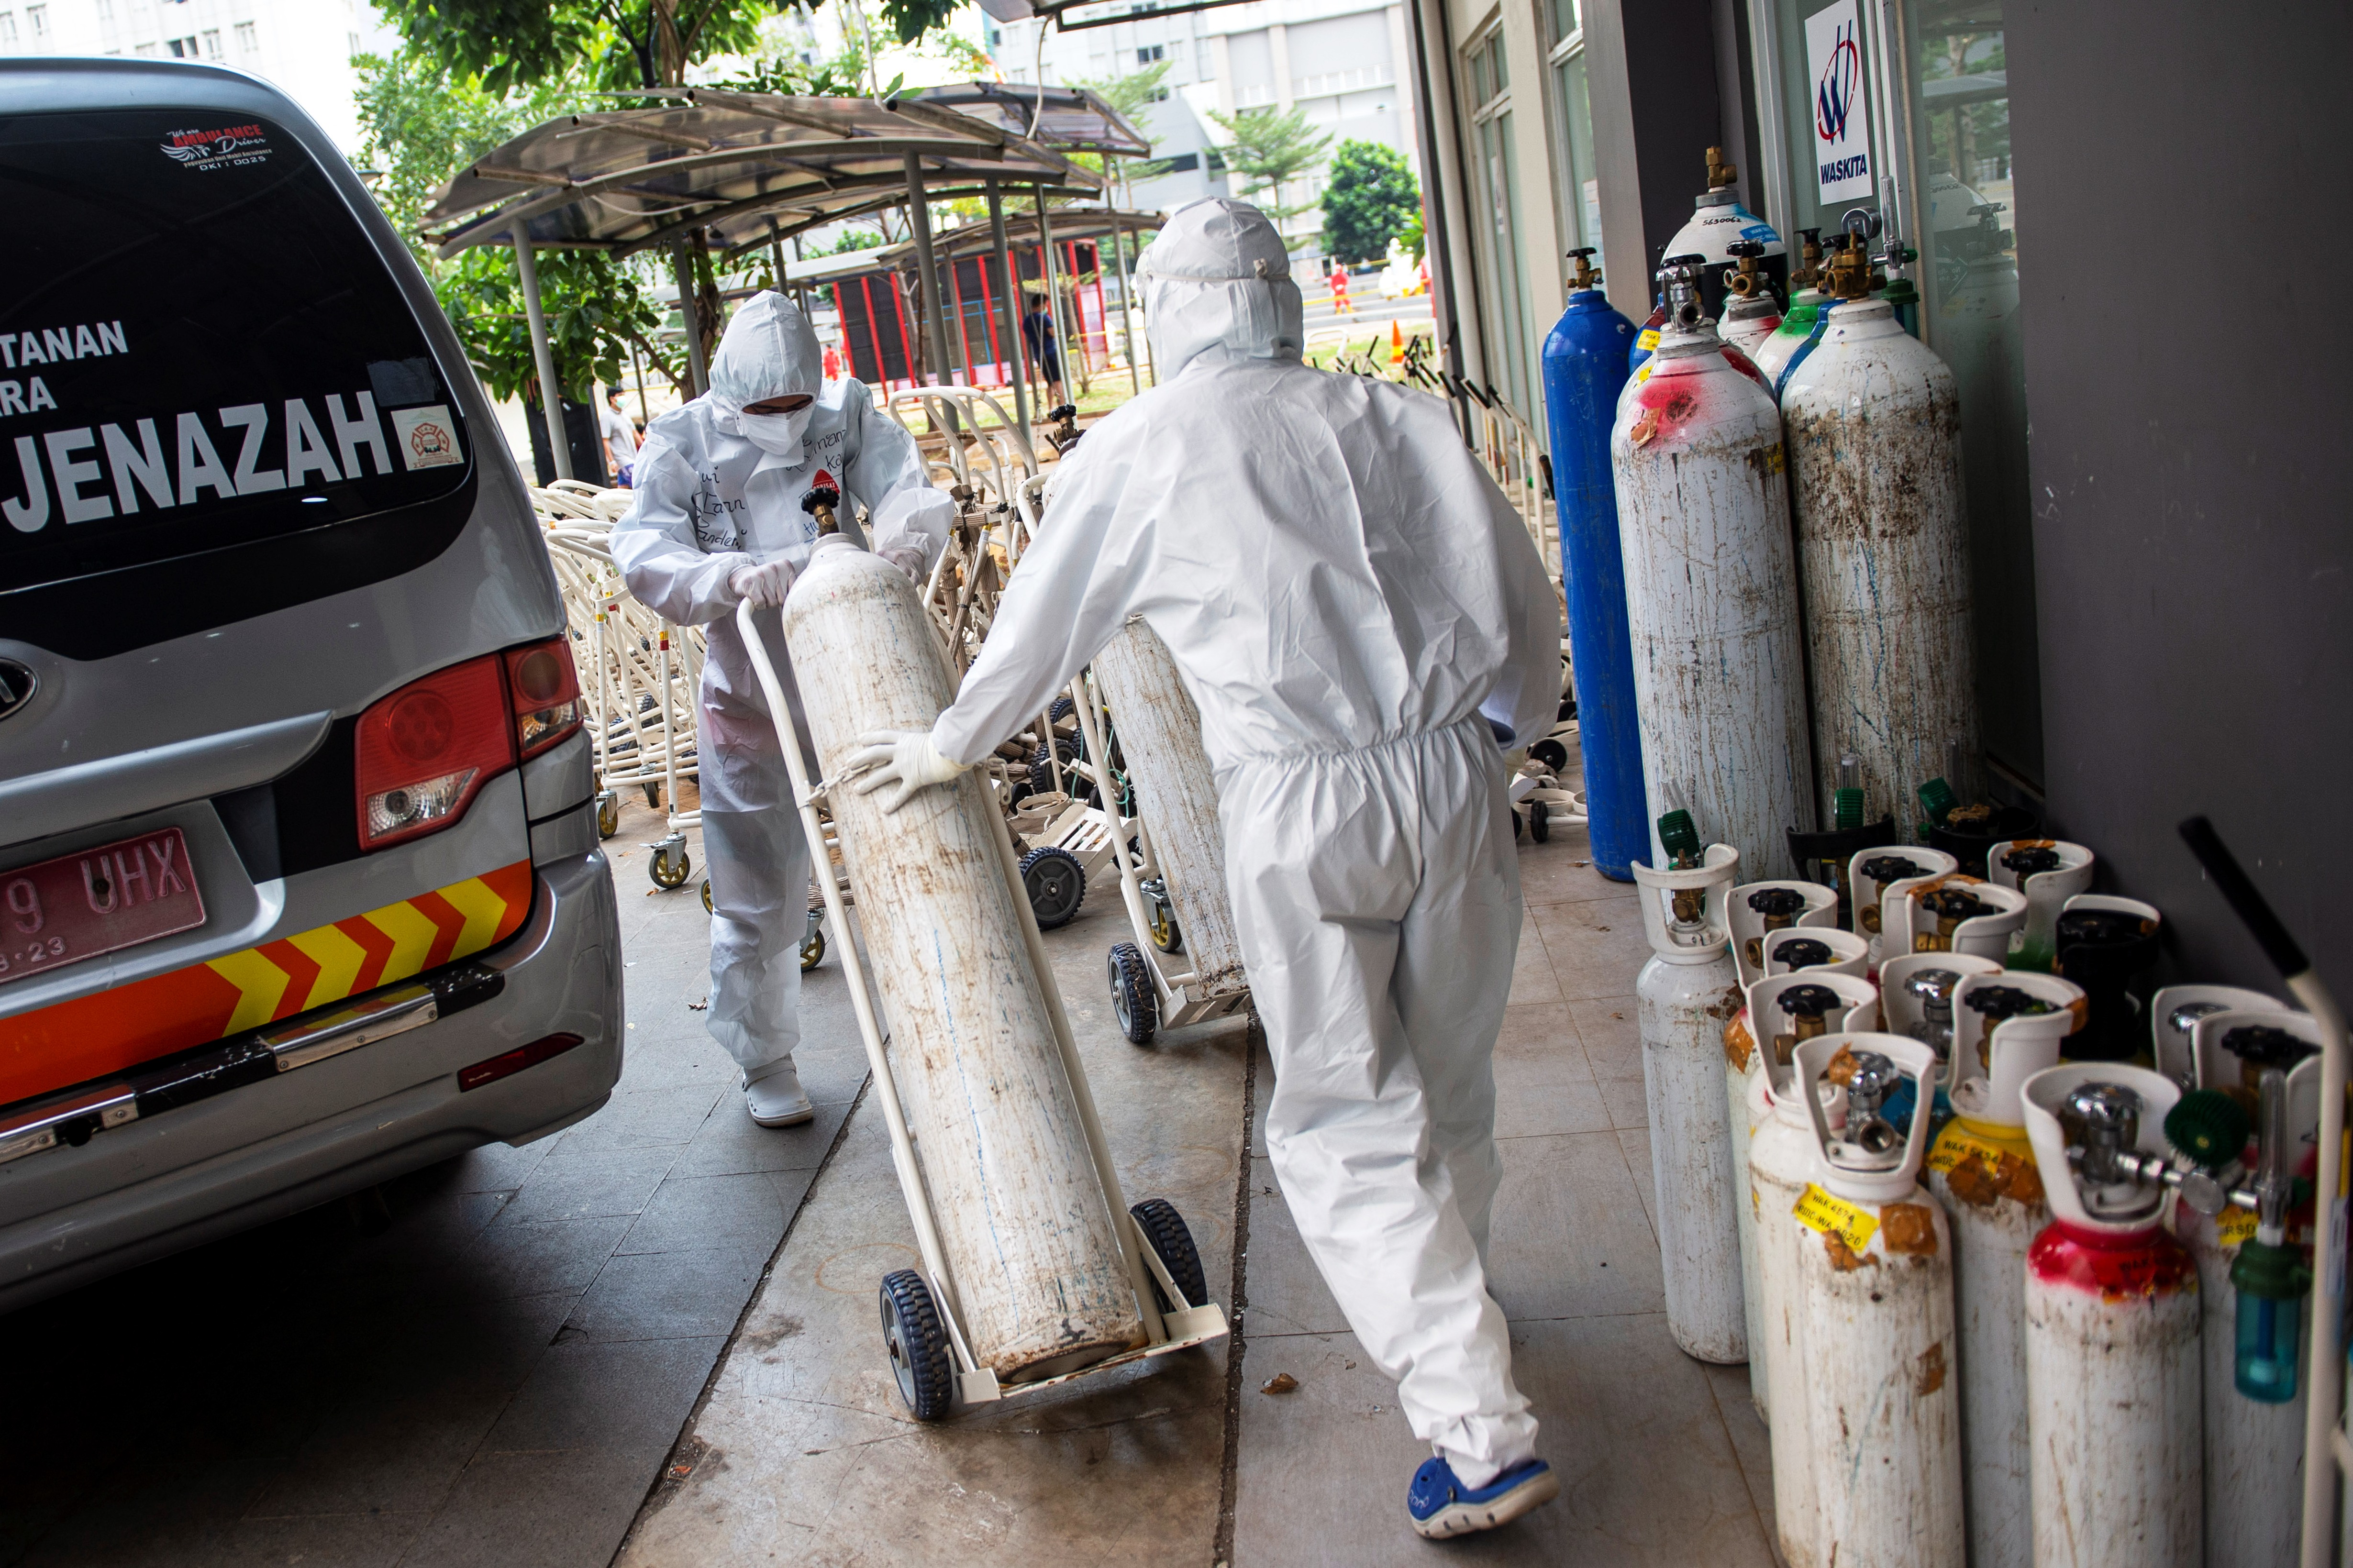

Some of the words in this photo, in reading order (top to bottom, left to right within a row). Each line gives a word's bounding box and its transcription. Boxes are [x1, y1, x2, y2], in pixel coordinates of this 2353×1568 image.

[166, 129, 185, 137] We
[173, 124, 264, 147] AMBULANCE
[215, 136, 266, 154] Driver
[233, 156, 266, 165] 0025
[1820, 154, 1867, 185] WASKITA
[1702, 217, 1742, 225] 5630062
[0, 376, 57, 417] RA
[1, 390, 393, 532] JENAZAH
[7, 878, 44, 933] 9
[80, 837, 186, 914] UHX
[1944, 1139, 1967, 1154] WAK
[1813, 1193, 1831, 1209] WAK
